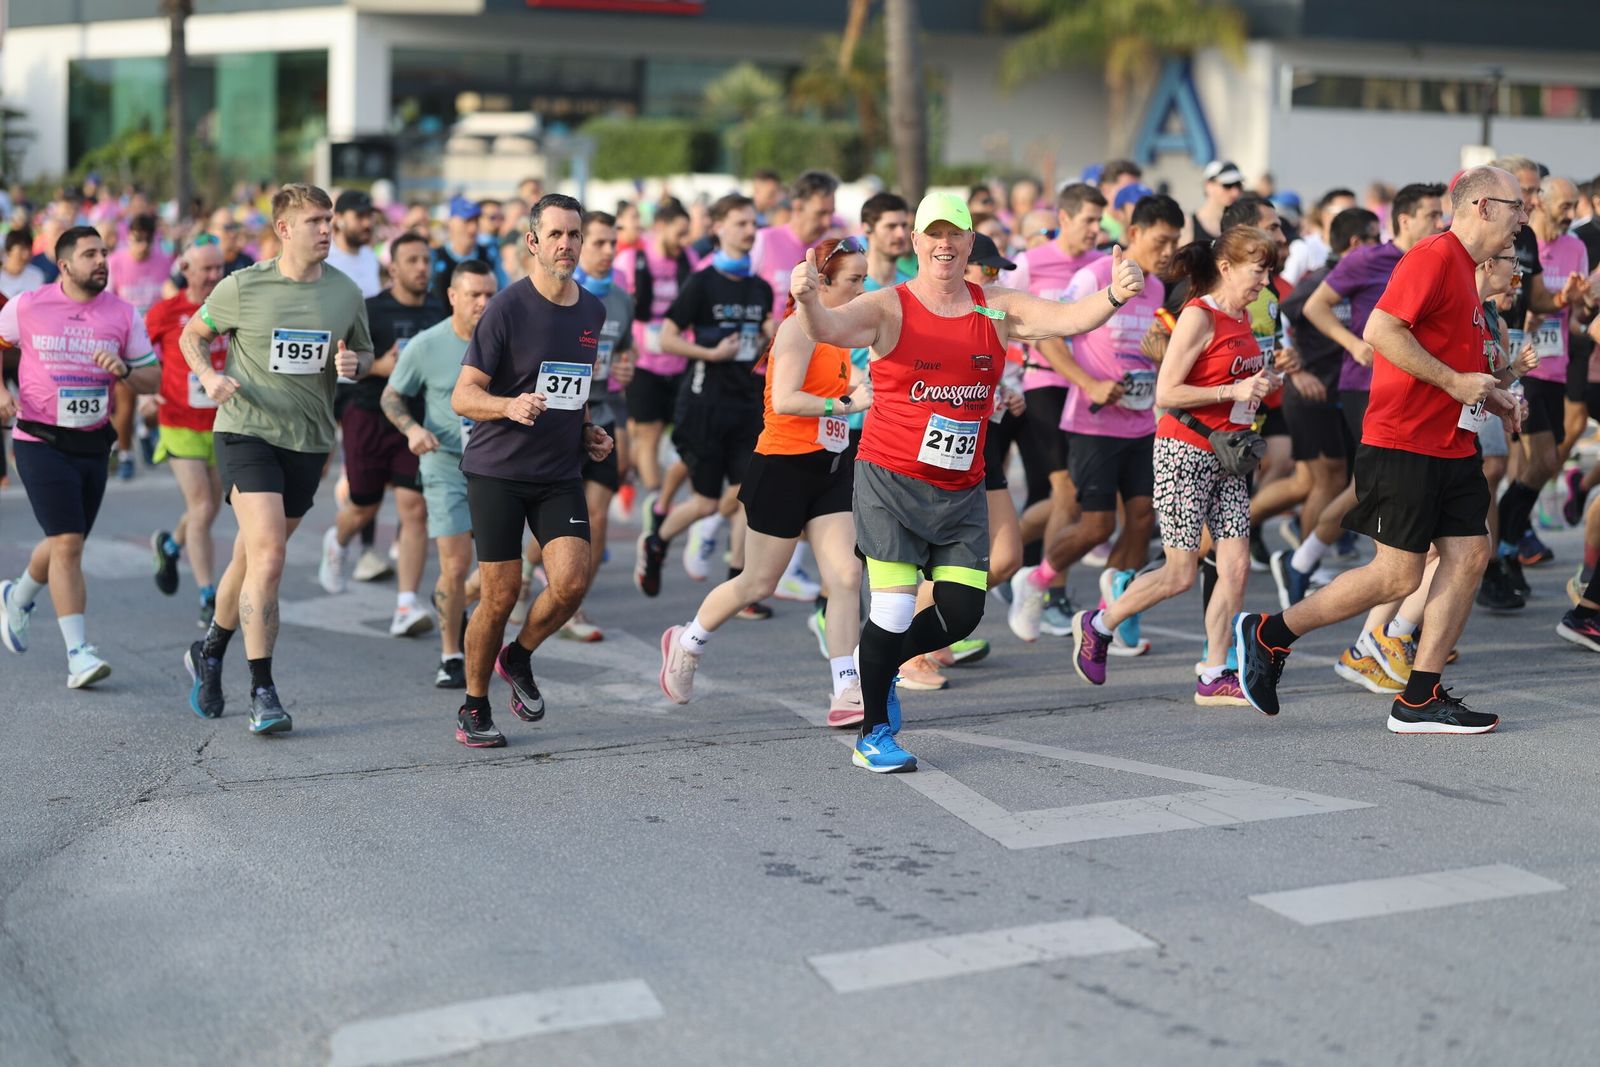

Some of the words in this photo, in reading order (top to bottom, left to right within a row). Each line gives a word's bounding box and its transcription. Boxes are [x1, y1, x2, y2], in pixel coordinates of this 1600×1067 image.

[1135, 57, 1217, 168] A
[31, 334, 67, 351] MEDIA
[276, 341, 324, 361] 1951
[914, 359, 943, 372] Dave
[547, 375, 583, 395] 371
[910, 380, 991, 407] Crossgates
[66, 399, 100, 414] 493
[826, 419, 846, 440] 993
[926, 430, 976, 455] 2132
